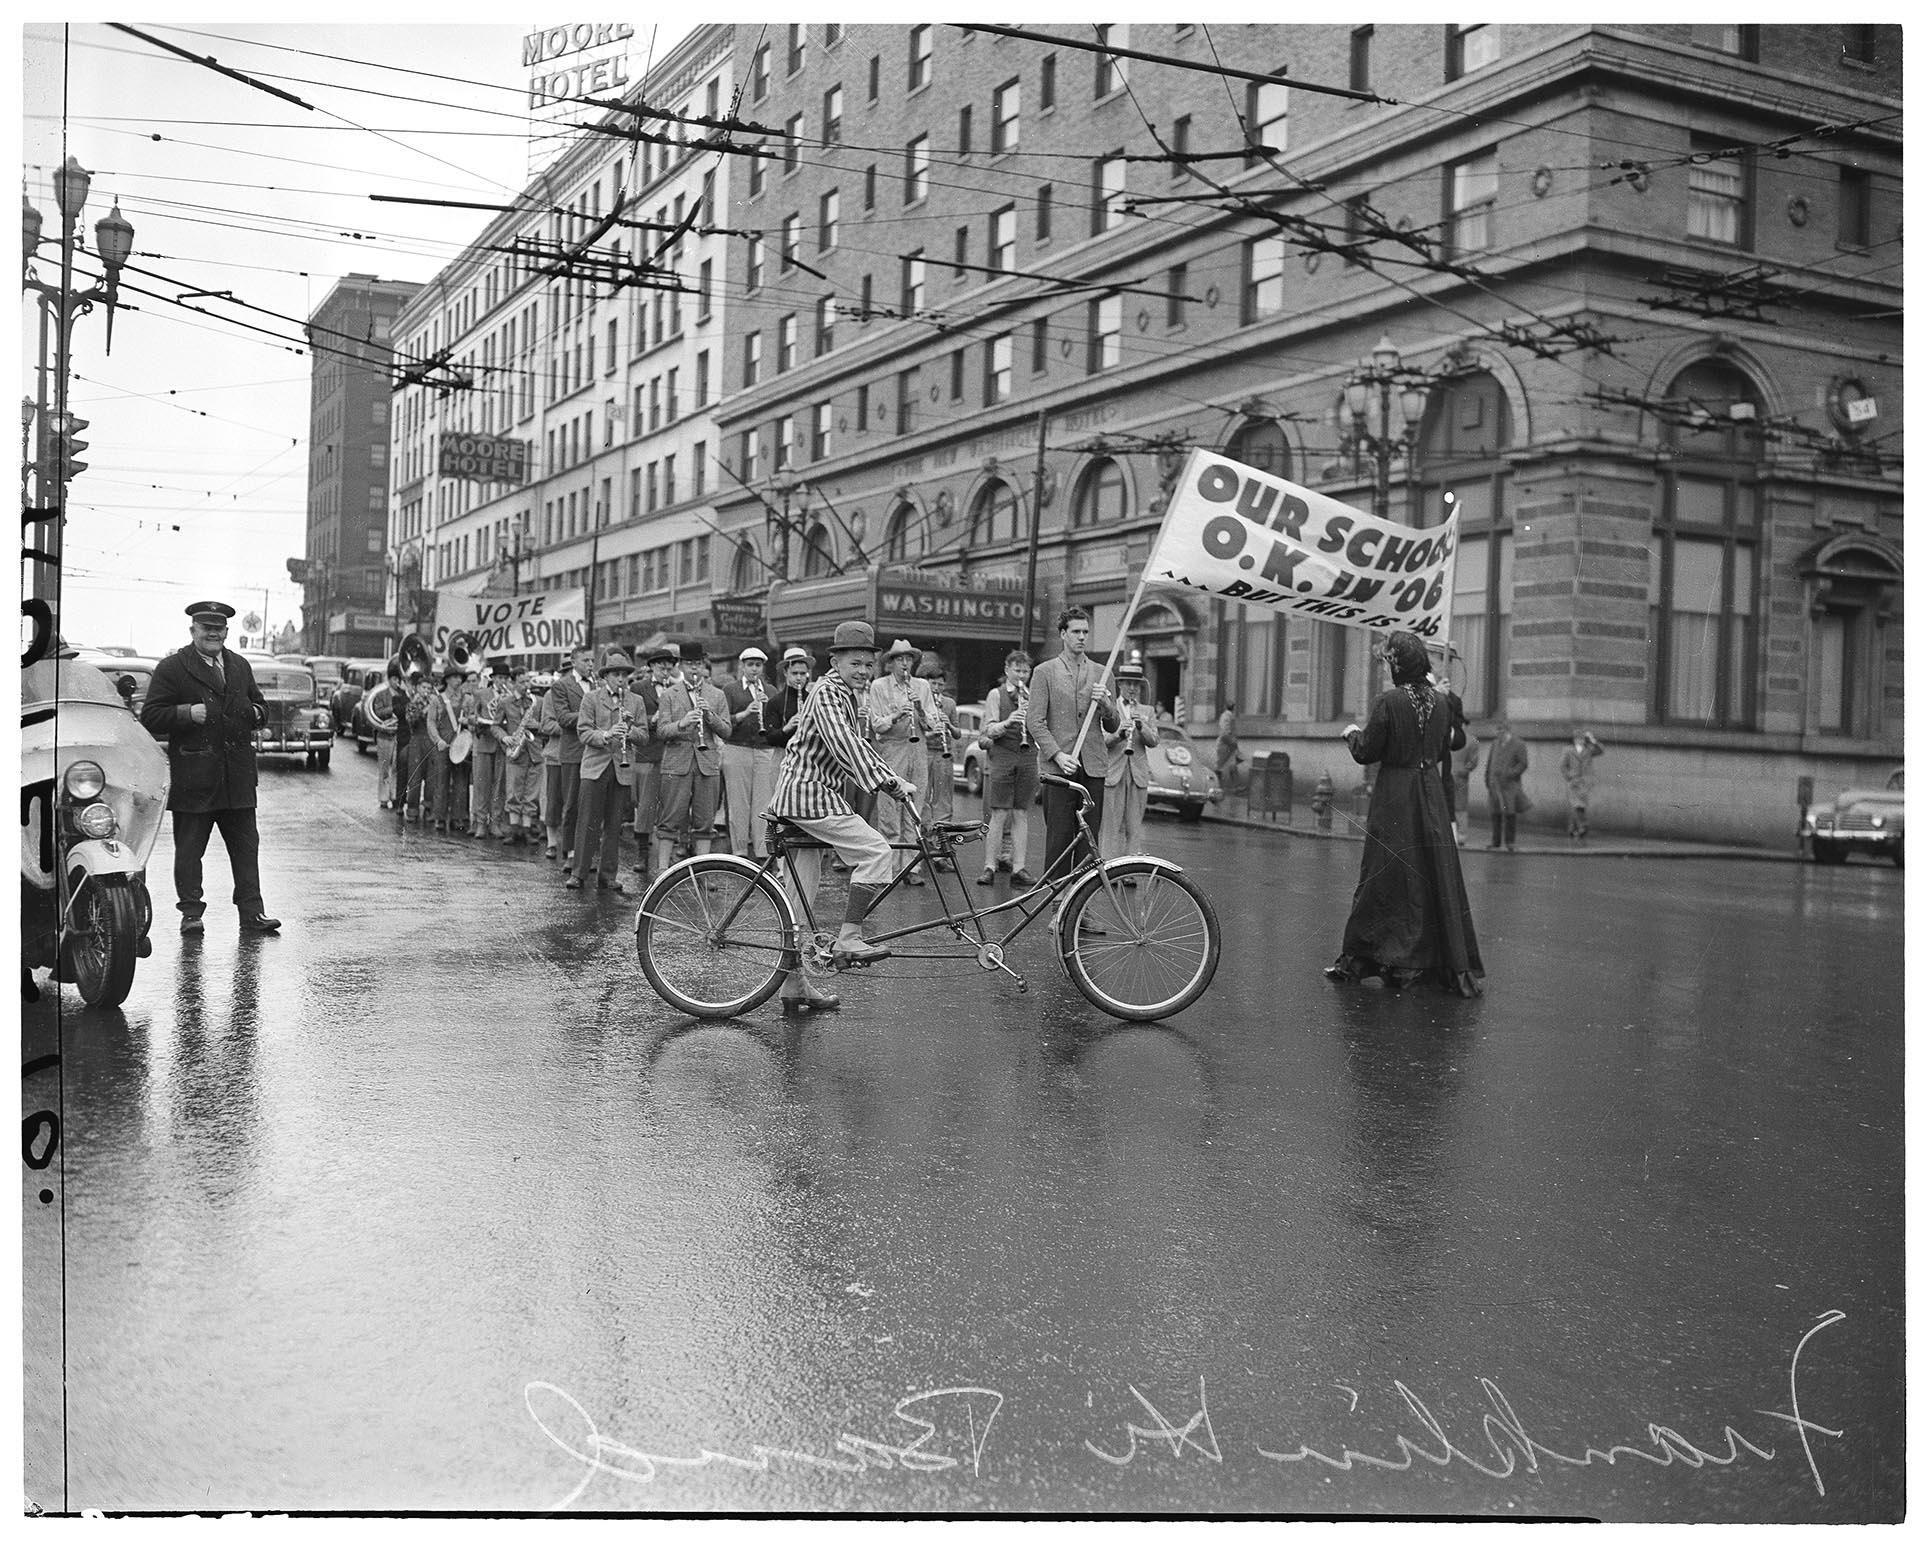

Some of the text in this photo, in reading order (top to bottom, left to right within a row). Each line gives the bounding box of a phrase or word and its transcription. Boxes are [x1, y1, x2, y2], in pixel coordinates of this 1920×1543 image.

[522, 23, 635, 67] MOORE
[528, 55, 630, 110] HOTEL
[440, 436, 524, 462] MOORE
[443, 454, 522, 479] HOTEL
[1197, 464, 1310, 542] OUR
[1202, 515, 1445, 613] O.K. IN '06
[475, 596, 546, 626] VOTE
[882, 593, 1042, 621] WASHINGTON
[1217, 579, 1441, 638] BUT THIS IS '46
[434, 619, 586, 654] SOOL BONDS
